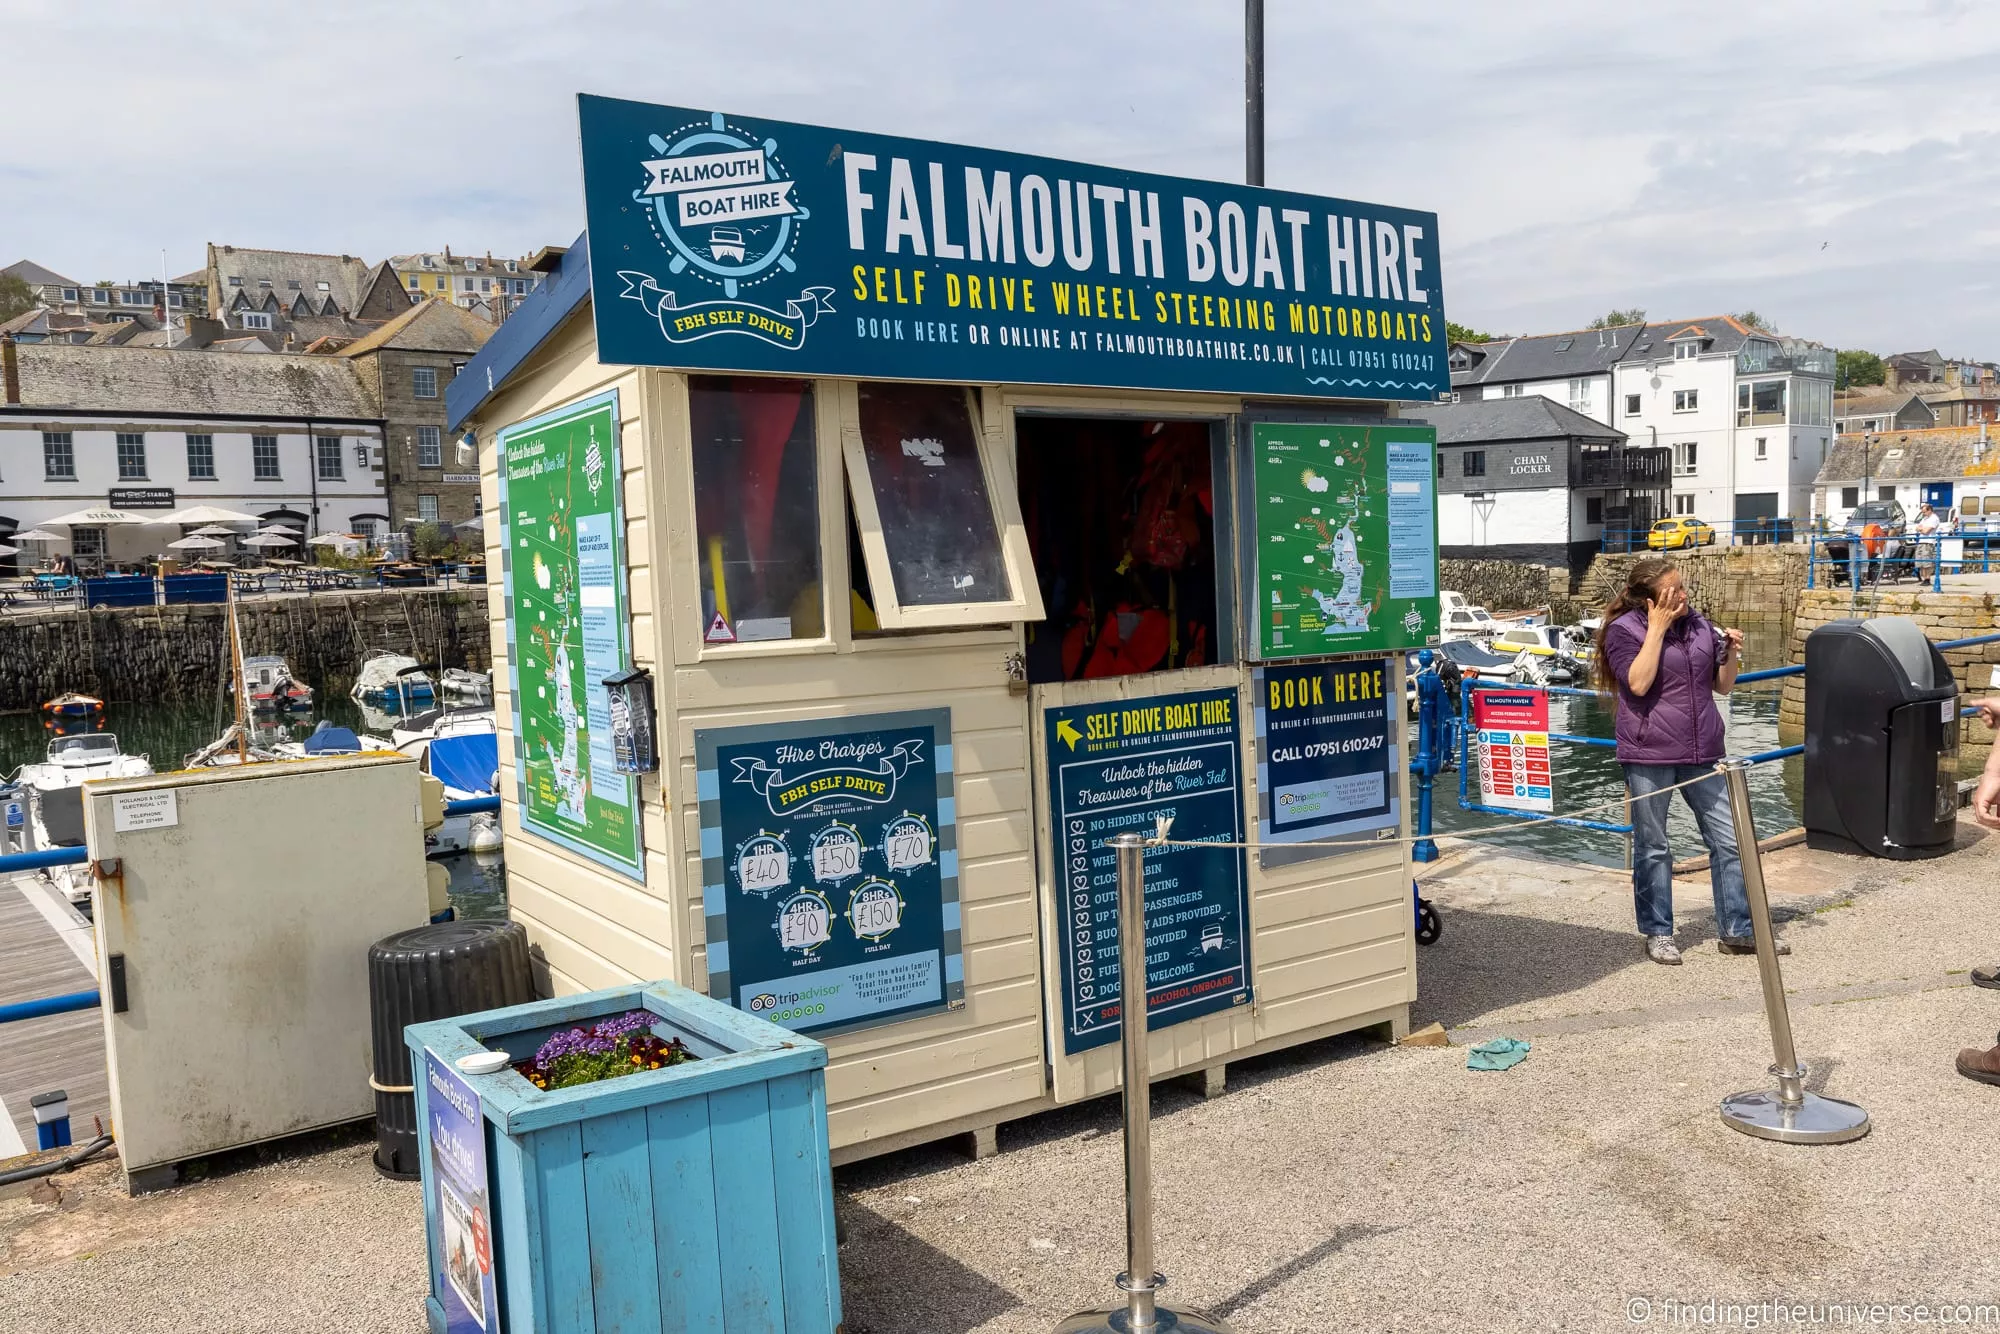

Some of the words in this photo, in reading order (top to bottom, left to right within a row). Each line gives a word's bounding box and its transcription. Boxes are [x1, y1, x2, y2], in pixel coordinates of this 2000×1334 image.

[660, 159, 760, 184] FALMOUTH
[686, 196, 737, 218] BOAT
[740, 192, 780, 211] HIRE
[843, 151, 1164, 279] FALMOUTH
[1183, 196, 1309, 292] BOAT
[1327, 214, 1428, 303] HIRE
[852, 264, 926, 305] SELF
[946, 273, 1036, 313] DRIVE
[1052, 281, 1141, 321] WHEEL
[1155, 291, 1275, 331] STEERING
[1289, 303, 1432, 343] MOTORBOATS
[674, 313, 707, 333] FBH
[709, 310, 745, 325] SELF
[748, 311, 795, 340] DRIVE
[856, 317, 904, 340] BOOK
[915, 321, 959, 344] HERE
[969, 324, 990, 345] OR
[1000, 326, 1060, 349] ONLINE
[1070, 331, 1087, 351] AT
[1096, 332, 1294, 365] FALMOUTHBOATHIRE.CO.UK
[1312, 347, 1343, 367] CALL
[1349, 350, 1386, 369] 07951
[1392, 352, 1434, 372] 610247
[1510, 464, 1552, 475] LOCKER
[1514, 455, 1548, 466] CHAIN
[1270, 676, 1324, 711] BOOK
[1334, 670, 1383, 703] HERE
[1086, 712, 1119, 741] SELF
[1122, 708, 1162, 735] DRIVE
[1164, 703, 1199, 731] BOAT
[1202, 699, 1232, 725] HIRE
[1280, 719, 1301, 729] ONLINE
[1303, 718, 1310, 727] AT
[775, 745, 816, 764] Hire
[819, 740, 886, 763] Charges
[1087, 743, 1103, 752] BOOK
[1105, 740, 1120, 750] HERE
[1121, 739, 1129, 748] OR
[1131, 736, 1151, 746] ONLINE
[1153, 735, 1160, 743] AT
[1272, 746, 1302, 763] CALL
[1305, 741, 1340, 758] 07951
[1342, 735, 1384, 753] 610247
[1101, 764, 1145, 784] Unlock
[1147, 761, 1165, 777] the
[1165, 756, 1203, 773] hidden
[779, 788, 809, 806] FBH
[811, 776, 842, 794] SELF
[845, 776, 886, 795] DRIVE
[1078, 786, 1139, 806] Treasures
[1140, 780, 1154, 800] of
[1154, 778, 1173, 793] the
[1175, 775, 1204, 791] River
[1206, 768, 1227, 785] Fal
[122, 802, 155, 810] ELECTRICAL
[130, 811, 162, 819] TELEPHONE
[895, 824, 921, 836] 3HRs
[1090, 820, 1105, 831] NO
[1107, 813, 1145, 828] HIDDEN
[1147, 808, 1176, 821] COSTS
[753, 843, 775, 856] 1HR
[822, 834, 851, 846] 2HRs
[891, 836, 923, 867] £70
[745, 858, 780, 883] £40
[820, 846, 855, 875] £50
[1092, 855, 1116, 868] WHE
[1093, 873, 1117, 886] CLOS
[1144, 879, 1179, 894] EATING
[862, 889, 890, 902] 8HRs
[1096, 912, 1111, 923] UP
[1144, 891, 1203, 912] PASSENGERS
[789, 903, 820, 914] 4HRs
[857, 902, 892, 929] £150
[1152, 915, 1175, 929] AIDS
[1176, 904, 1222, 922] PROVIDED
[784, 913, 818, 942] £90
[1145, 930, 1187, 948] ROVIDED
[864, 945, 878, 954] FULL
[878, 943, 891, 952] DAY
[792, 957, 808, 967] HALF
[808, 956, 822, 965] DAY
[891, 964, 909, 974] whole
[1149, 962, 1195, 983] WELCOME
[779, 985, 842, 1005] tripadvisor
[1101, 1006, 1120, 1020] SOR
[1150, 987, 1191, 1006] ALCOHOL
[1192, 975, 1234, 994] ONBOARD
[429, 1063, 450, 1101] Falmouth
[450, 1082, 463, 1113] Boat
[462, 1093, 475, 1125] Hire
[435, 1112, 450, 1150] You
[452, 1133, 476, 1177] drive!
